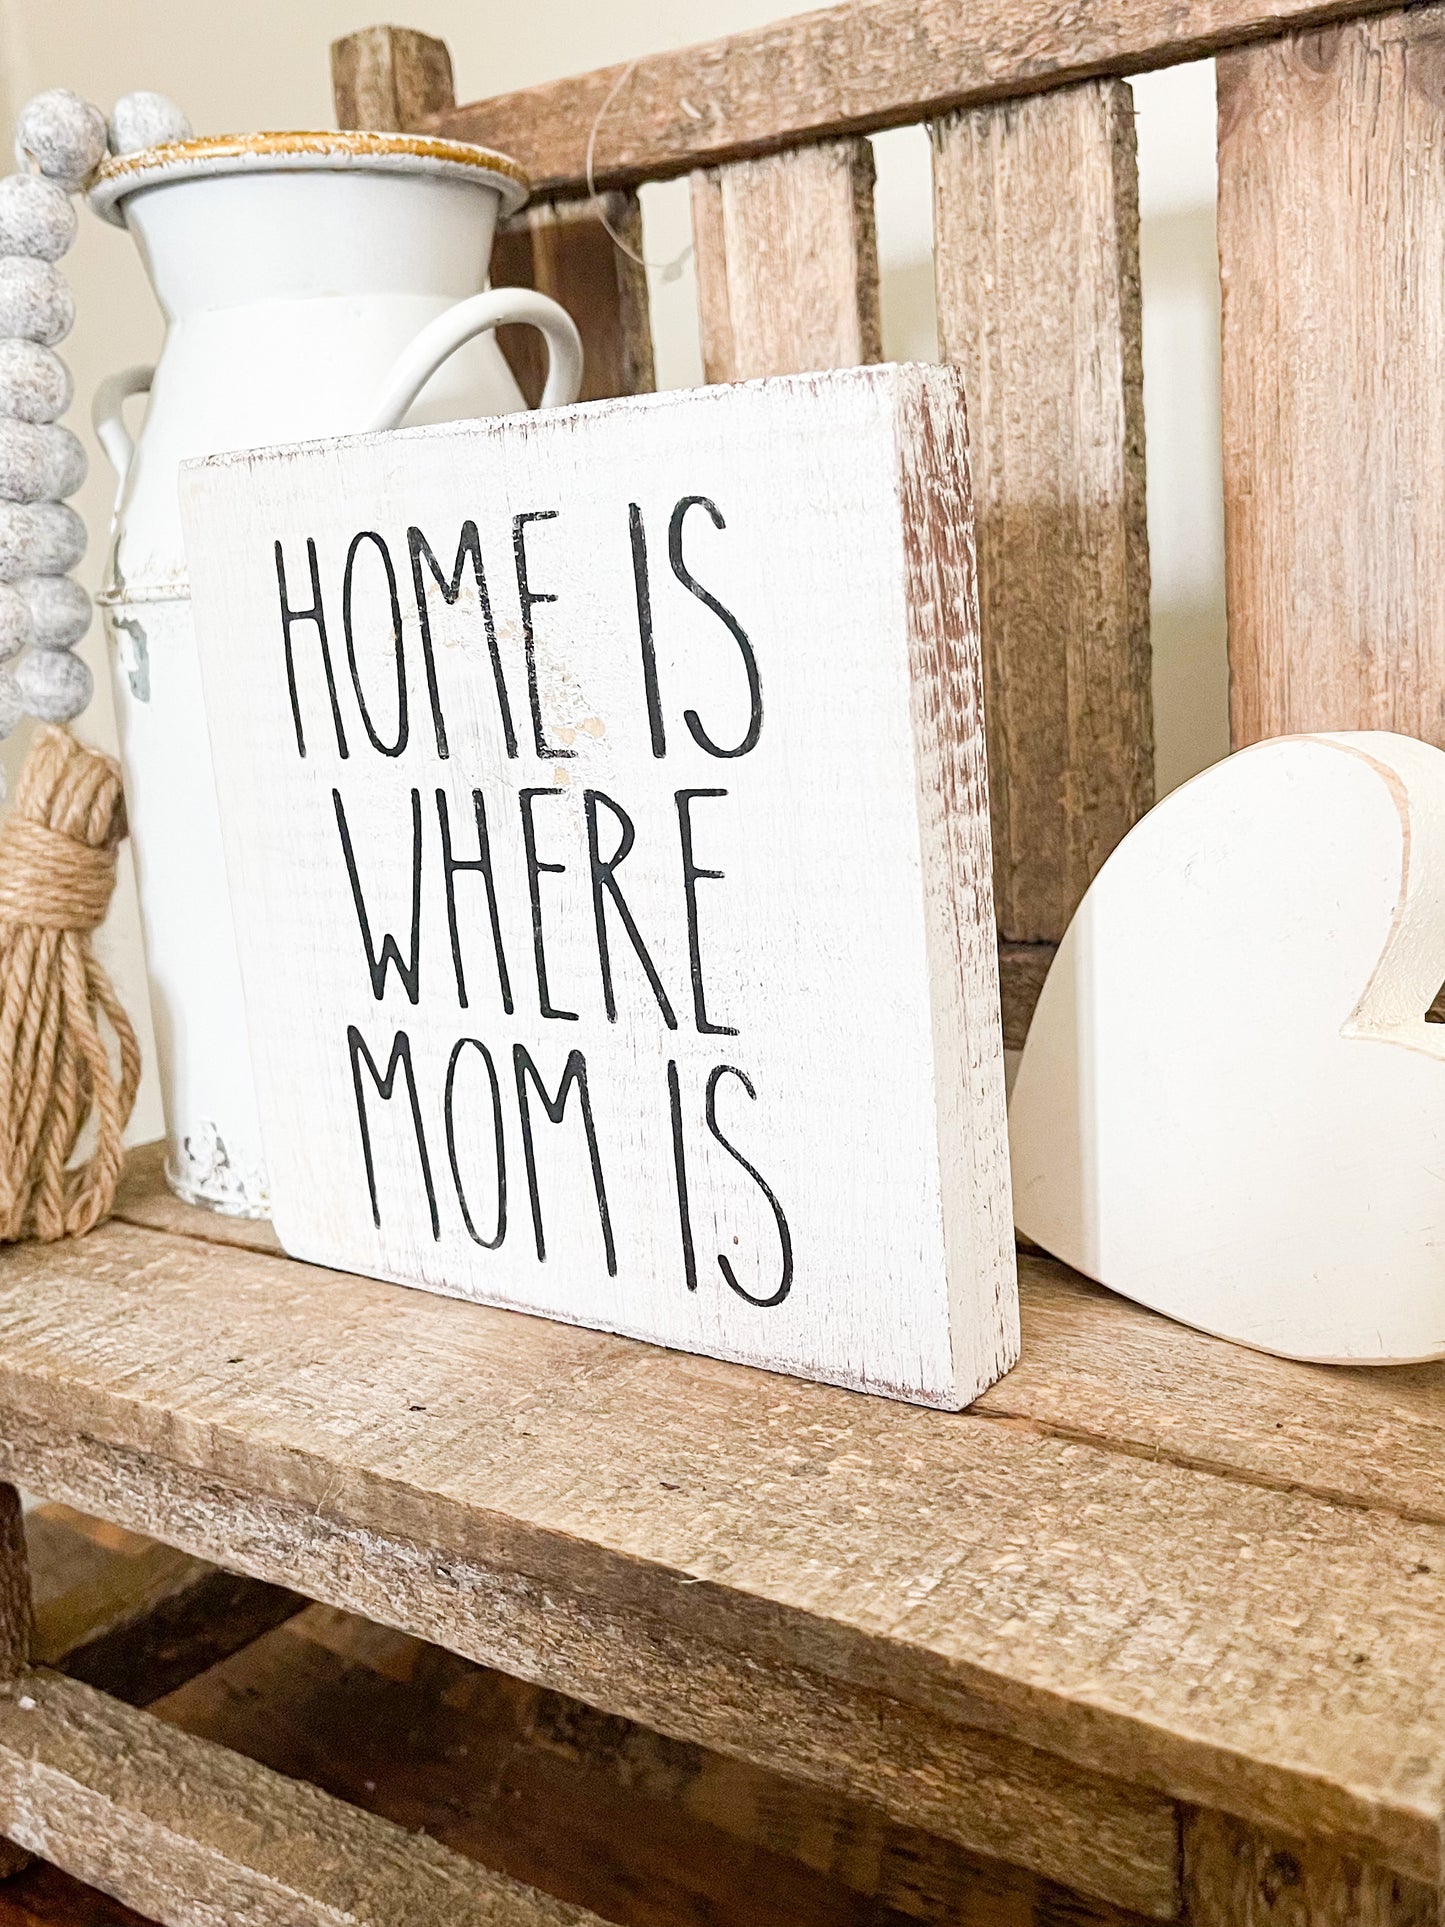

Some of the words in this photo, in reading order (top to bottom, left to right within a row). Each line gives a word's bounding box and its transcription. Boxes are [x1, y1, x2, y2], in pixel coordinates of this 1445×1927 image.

[275, 511, 577, 760] HOME
[629, 496, 763, 758] IS
[332, 788, 739, 1036] WHERE
[347, 1025, 617, 1277] MOM
[668, 1060, 793, 1307] IS
